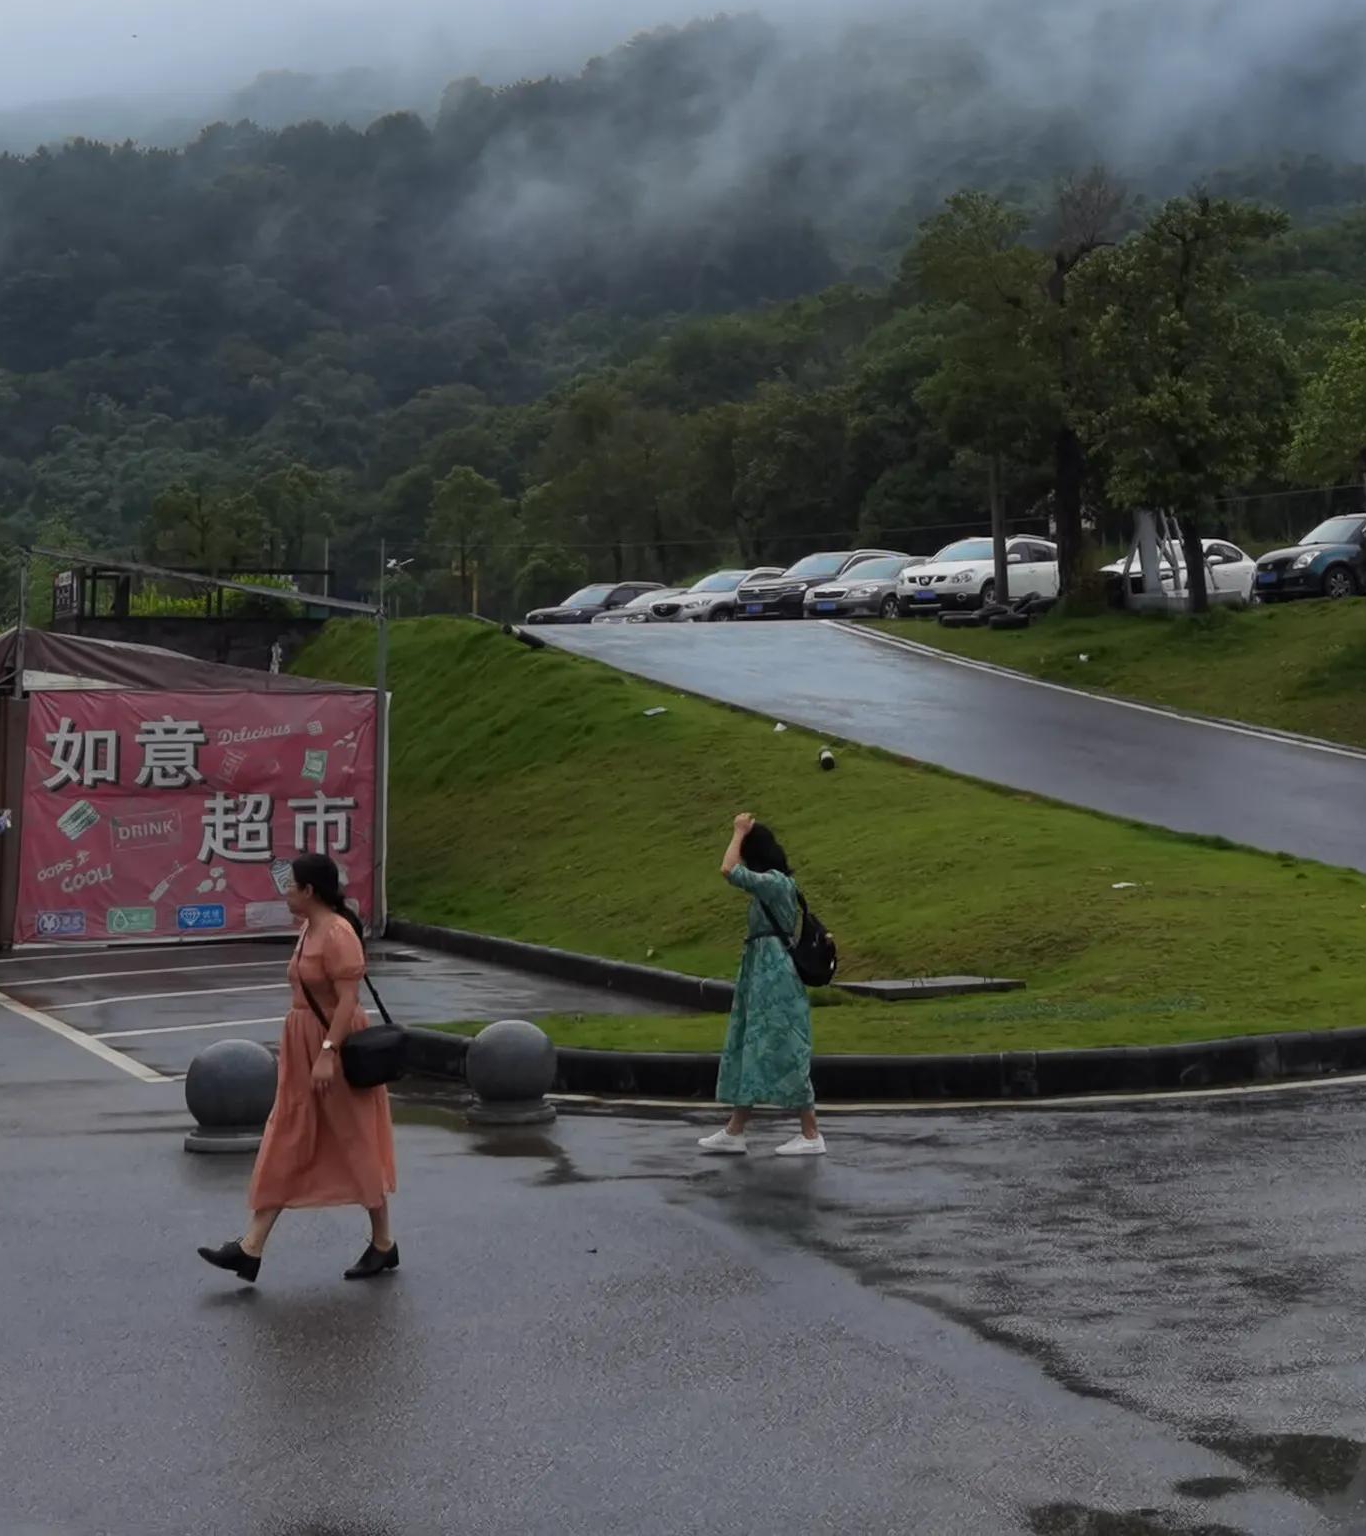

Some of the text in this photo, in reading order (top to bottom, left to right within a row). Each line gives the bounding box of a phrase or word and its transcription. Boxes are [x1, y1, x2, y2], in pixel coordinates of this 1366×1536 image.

[43, 716, 206, 789] 如意
[217, 723, 292, 746] Delicious
[118, 820, 174, 840] DRINK
[197, 790, 357, 863] 超市
